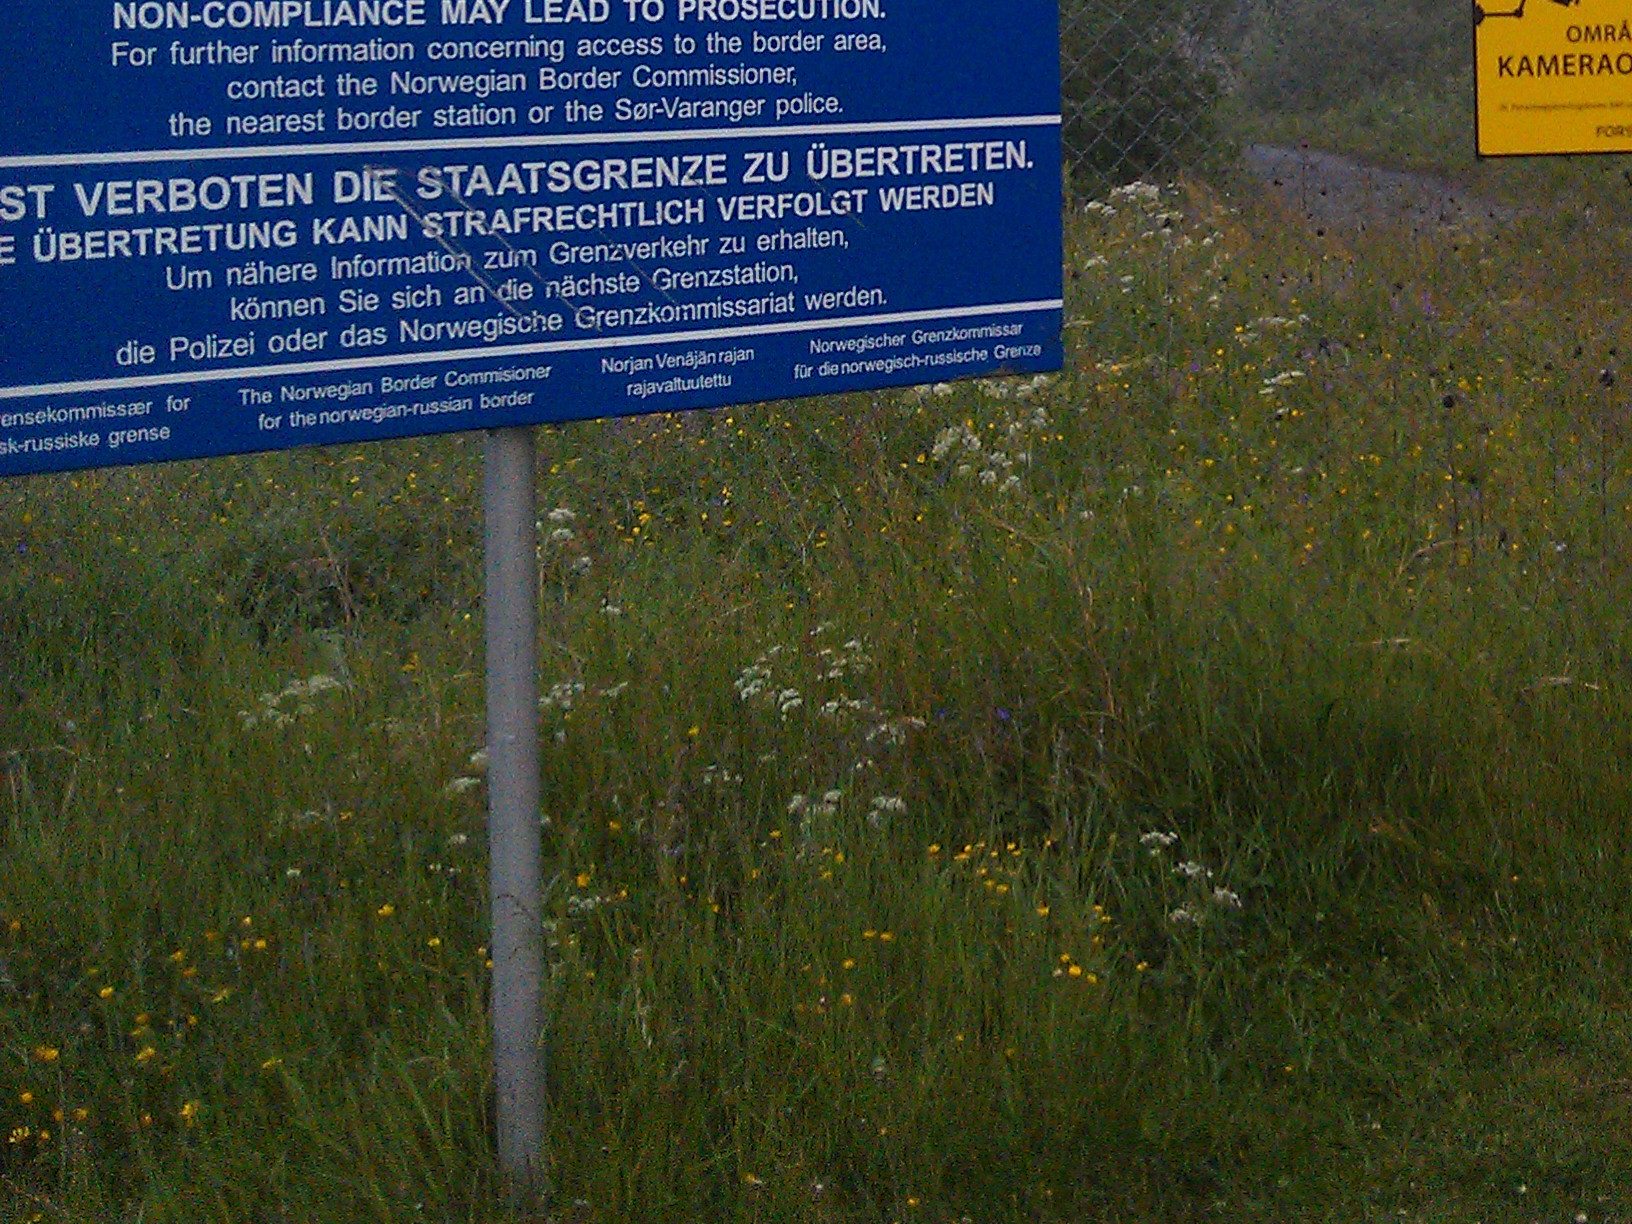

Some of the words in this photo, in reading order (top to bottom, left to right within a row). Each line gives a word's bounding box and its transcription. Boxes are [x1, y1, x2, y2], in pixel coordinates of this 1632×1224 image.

[113, 0, 426, 30] NON-COMPLIANCE
[112, 41, 157, 66] For
[170, 39, 259, 65] further
[272, 37, 414, 63] information
[427, 39, 564, 63] concerning
[577, 36, 663, 57] access
[674, 33, 696, 54] to
[706, 31, 742, 54] the
[753, 30, 825, 53] border
[833, 33, 886, 52] area,
[227, 74, 325, 99] contact
[336, 73, 377, 96] the
[391, 71, 526, 98] Norwegian
[539, 66, 622, 90] Border
[632, 64, 797, 88] Commissioner,
[169, 112, 212, 137] the
[227, 109, 325, 134] nearest
[337, 105, 422, 130] border
[433, 104, 516, 127] station
[528, 105, 554, 124] or
[565, 99, 604, 122] the
[615, 96, 766, 122] Sør-Varanger
[776, 92, 844, 120] police.
[73, 172, 313, 217] VERBOTEN
[333, 169, 399, 204] DIE
[416, 154, 727, 199] STAATSGRENZE
[742, 151, 789, 183] ZU
[807, 140, 1034, 180] ÜBERTRETEN.
[33, 220, 297, 263] ÜBERTRETUNG
[313, 214, 407, 245] KANN
[420, 198, 704, 239] STRAFRECHTLICH
[716, 189, 868, 221] VERFOLGT
[878, 182, 994, 212] WERDEN
[166, 265, 212, 290] Um
[226, 260, 318, 286] nähere
[331, 251, 471, 279] Information
[483, 249, 537, 269] zum
[549, 234, 710, 265] Grenzverkehr
[719, 236, 745, 254] zu
[756, 227, 849, 251] erhalten,
[231, 297, 325, 321] können
[339, 289, 379, 313] Sie
[392, 284, 441, 309] sich
[454, 286, 485, 305] an
[497, 279, 533, 302] die
[546, 272, 640, 298] nächste
[652, 262, 798, 291] Grenzstation,
[116, 340, 155, 366] die
[170, 334, 255, 361] Polizei
[268, 328, 328, 353] oder
[340, 324, 387, 348] das
[400, 310, 563, 343] Norwegische
[575, 292, 795, 329] Grenzkommissariat
[804, 286, 888, 310] werden.
[810, 333, 906, 354] Norwegischer
[911, 324, 1023, 345] Grenzkommissar
[601, 357, 654, 375] Norjan
[794, 364, 813, 379] für
[993, 344, 1042, 359] Grenze
[166, 395, 191, 412] for
[238, 388, 273, 405] The
[281, 382, 373, 401] Norwegian
[381, 374, 438, 393] Border
[627, 373, 732, 399] rajavaltuutettu
[258, 413, 282, 430] for
[480, 391, 534, 409] border
[108, 426, 171, 449] grense
